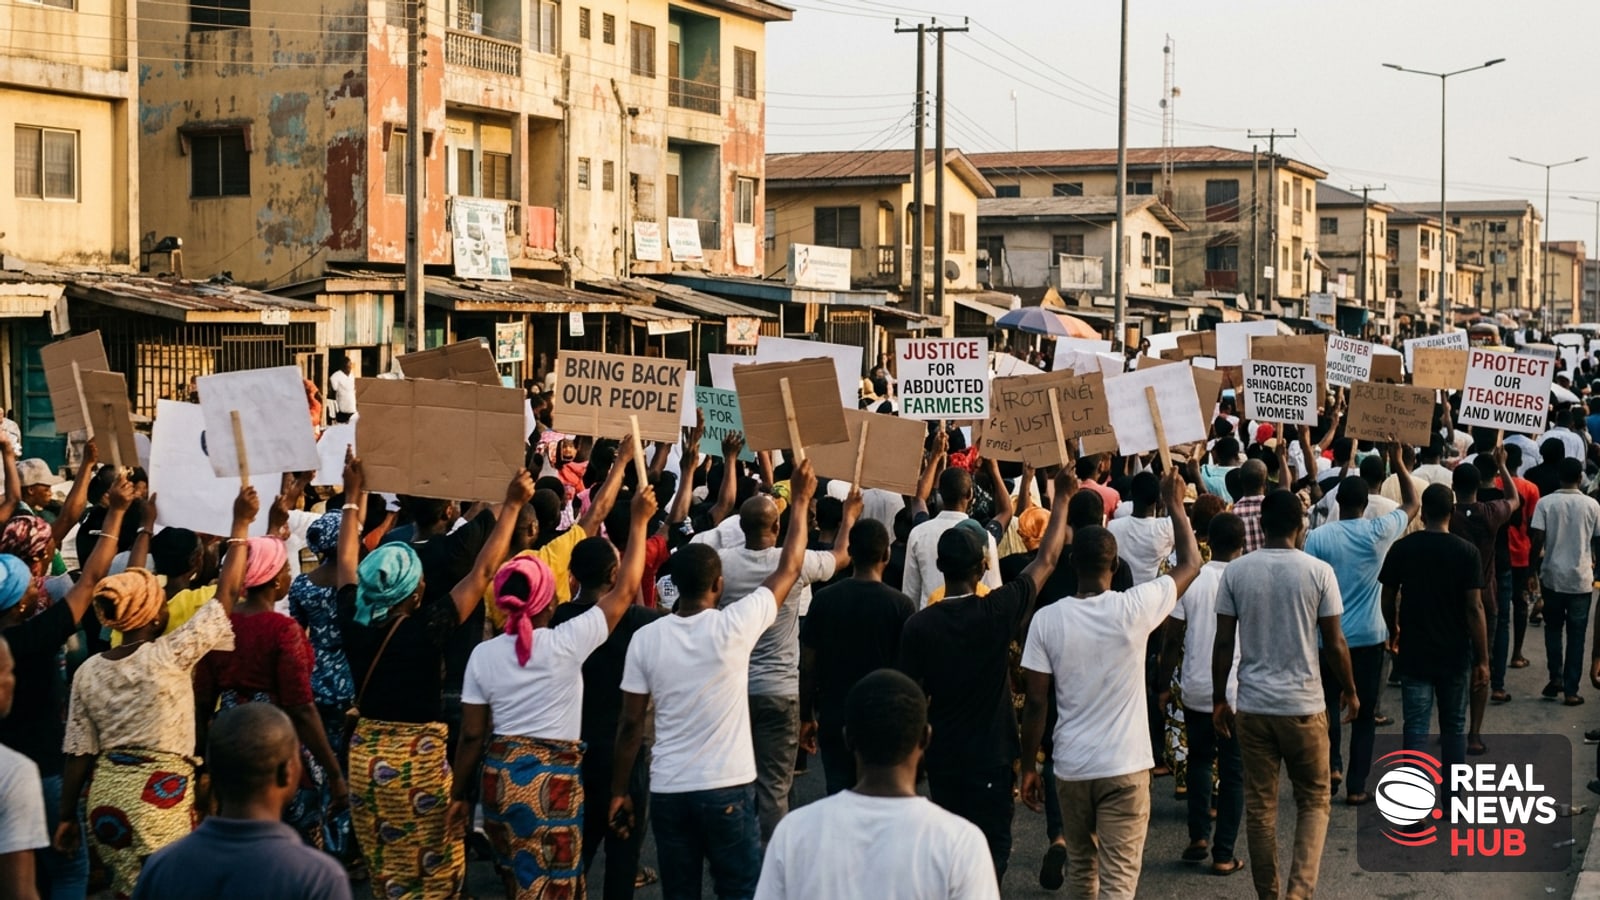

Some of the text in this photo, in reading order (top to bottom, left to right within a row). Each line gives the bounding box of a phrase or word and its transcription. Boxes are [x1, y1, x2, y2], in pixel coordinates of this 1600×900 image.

[903, 342, 979, 360] JUSTICE
[565, 357, 682, 387] BRING BACK
[928, 363, 955, 376] FOR
[1253, 364, 1306, 379] PROTECT
[1472, 352, 1549, 377] PROTECT
[903, 379, 984, 394] ABDUCTED
[1494, 375, 1521, 390] OUR
[563, 384, 678, 413] OUR PEOPLE
[904, 397, 985, 414] FARMERS
[1253, 392, 1308, 407] TEACHERS
[1468, 387, 1545, 412] TEACHERS
[709, 409, 734, 424] FOR
[1463, 405, 1542, 428] AND WOMEN
